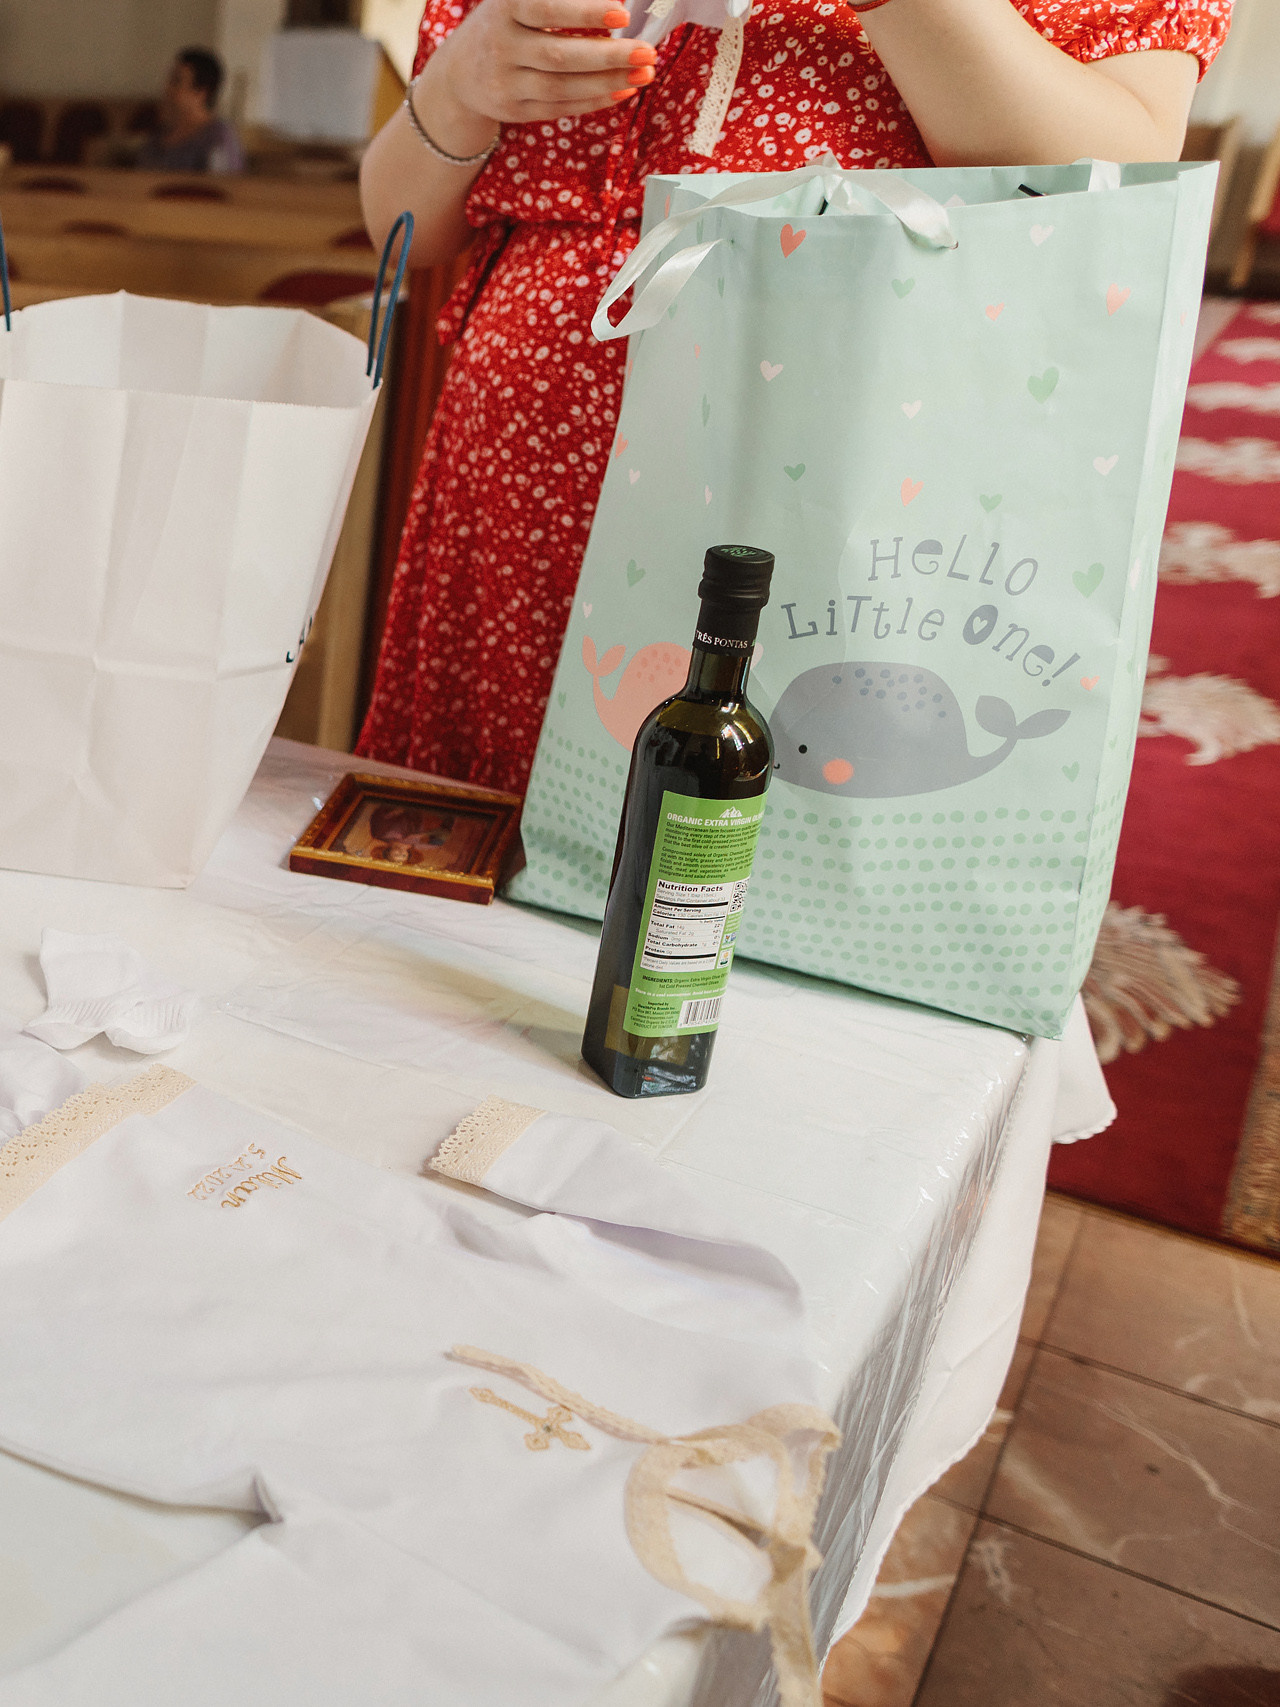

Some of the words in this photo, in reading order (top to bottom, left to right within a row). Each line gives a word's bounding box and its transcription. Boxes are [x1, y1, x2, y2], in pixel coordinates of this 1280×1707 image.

[714, 637, 748, 649] PONTAS
[667, 812, 703, 825] ORGANIC
[730, 816, 751, 826] VIRGIN
[659, 881, 698, 892] Nutrition
[662, 941, 697, 949] Carbohydrate
[220, 1156, 303, 1209] Milan
